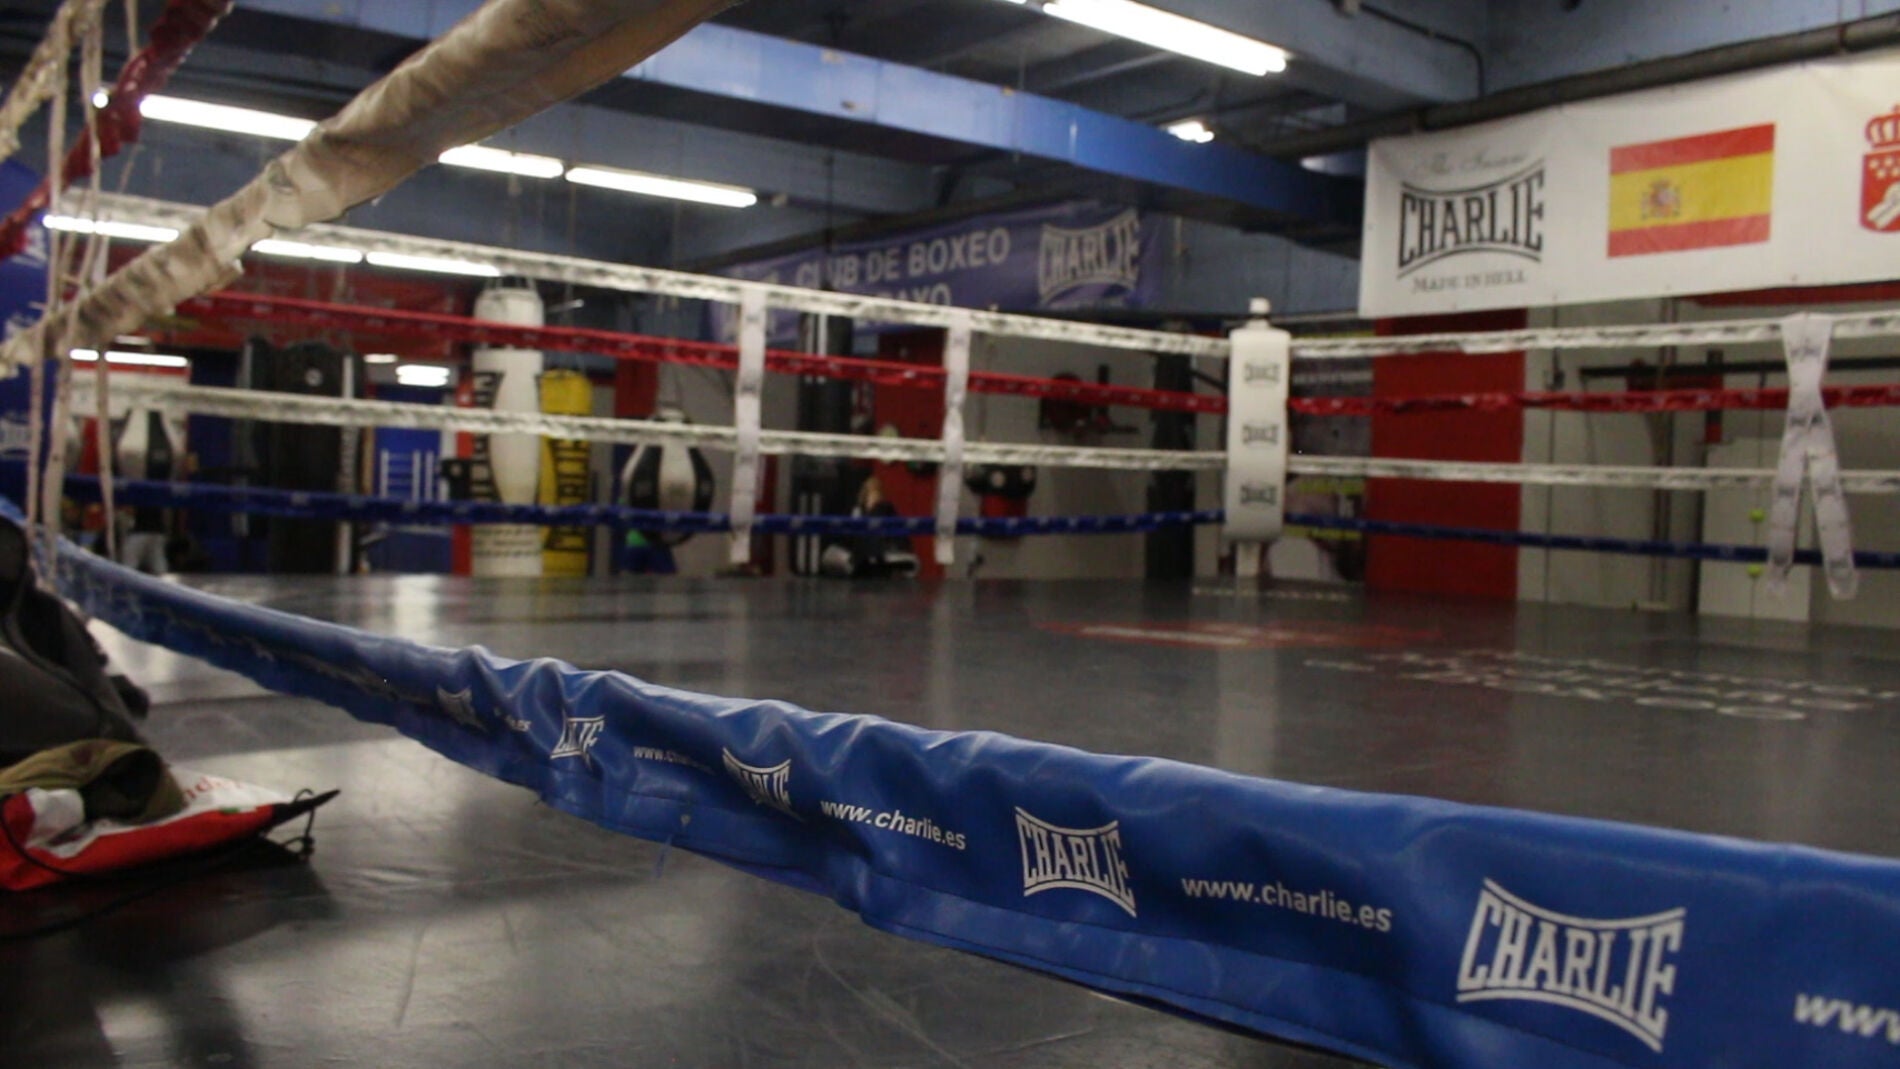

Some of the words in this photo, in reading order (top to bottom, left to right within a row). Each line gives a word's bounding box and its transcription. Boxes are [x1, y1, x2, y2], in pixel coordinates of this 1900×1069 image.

[865, 249, 899, 281] DE
[908, 228, 1011, 276] BOXEO
[1039, 215, 1140, 298] CHARLIE
[1398, 168, 1545, 269] CHARLIE
[820, 800, 966, 851] www.charlie.es
[1016, 813, 1135, 907] CHARLIE
[1181, 877, 1393, 932] www.charlie.es
[1457, 889, 1685, 1039] CHARLIE
